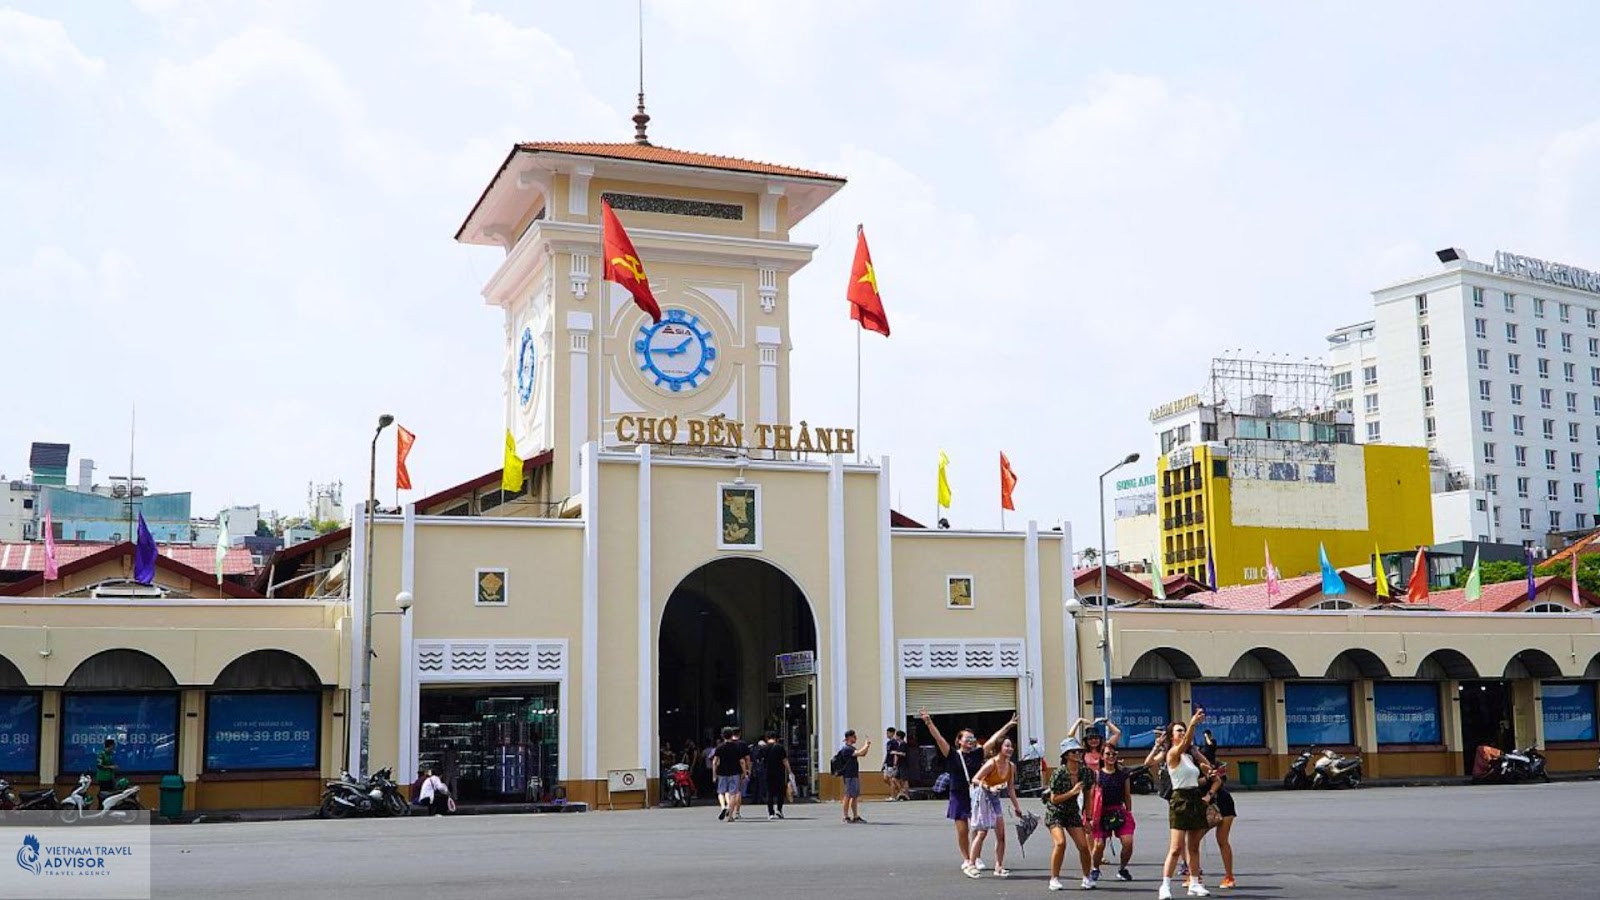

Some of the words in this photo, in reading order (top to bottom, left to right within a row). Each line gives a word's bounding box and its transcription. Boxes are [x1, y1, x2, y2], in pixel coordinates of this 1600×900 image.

[616, 415, 678, 445] CHỢ
[687, 413, 744, 448] BẾN
[754, 420, 855, 453] THÀNH
[216, 730, 310, 742] 0969.39.89.89
